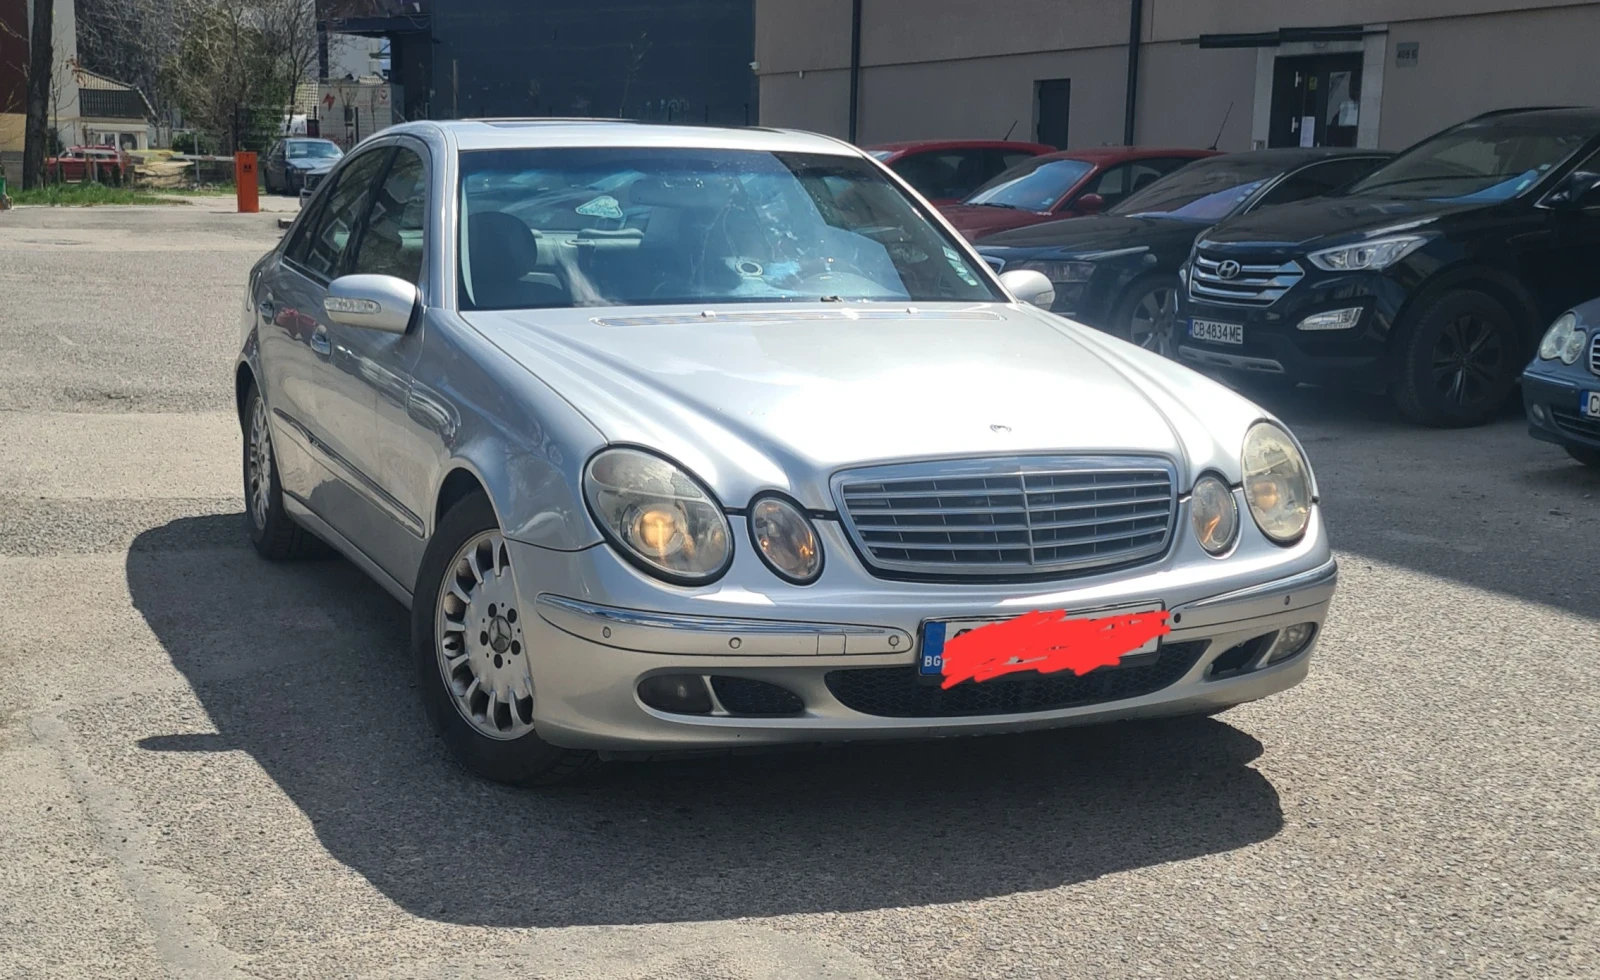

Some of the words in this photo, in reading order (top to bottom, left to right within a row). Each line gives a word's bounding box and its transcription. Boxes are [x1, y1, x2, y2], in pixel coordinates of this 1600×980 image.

[1206, 324, 1228, 340] 4834
[1229, 325, 1242, 342] ME
[1590, 395, 1600, 414] C
[924, 655, 941, 667] BG
